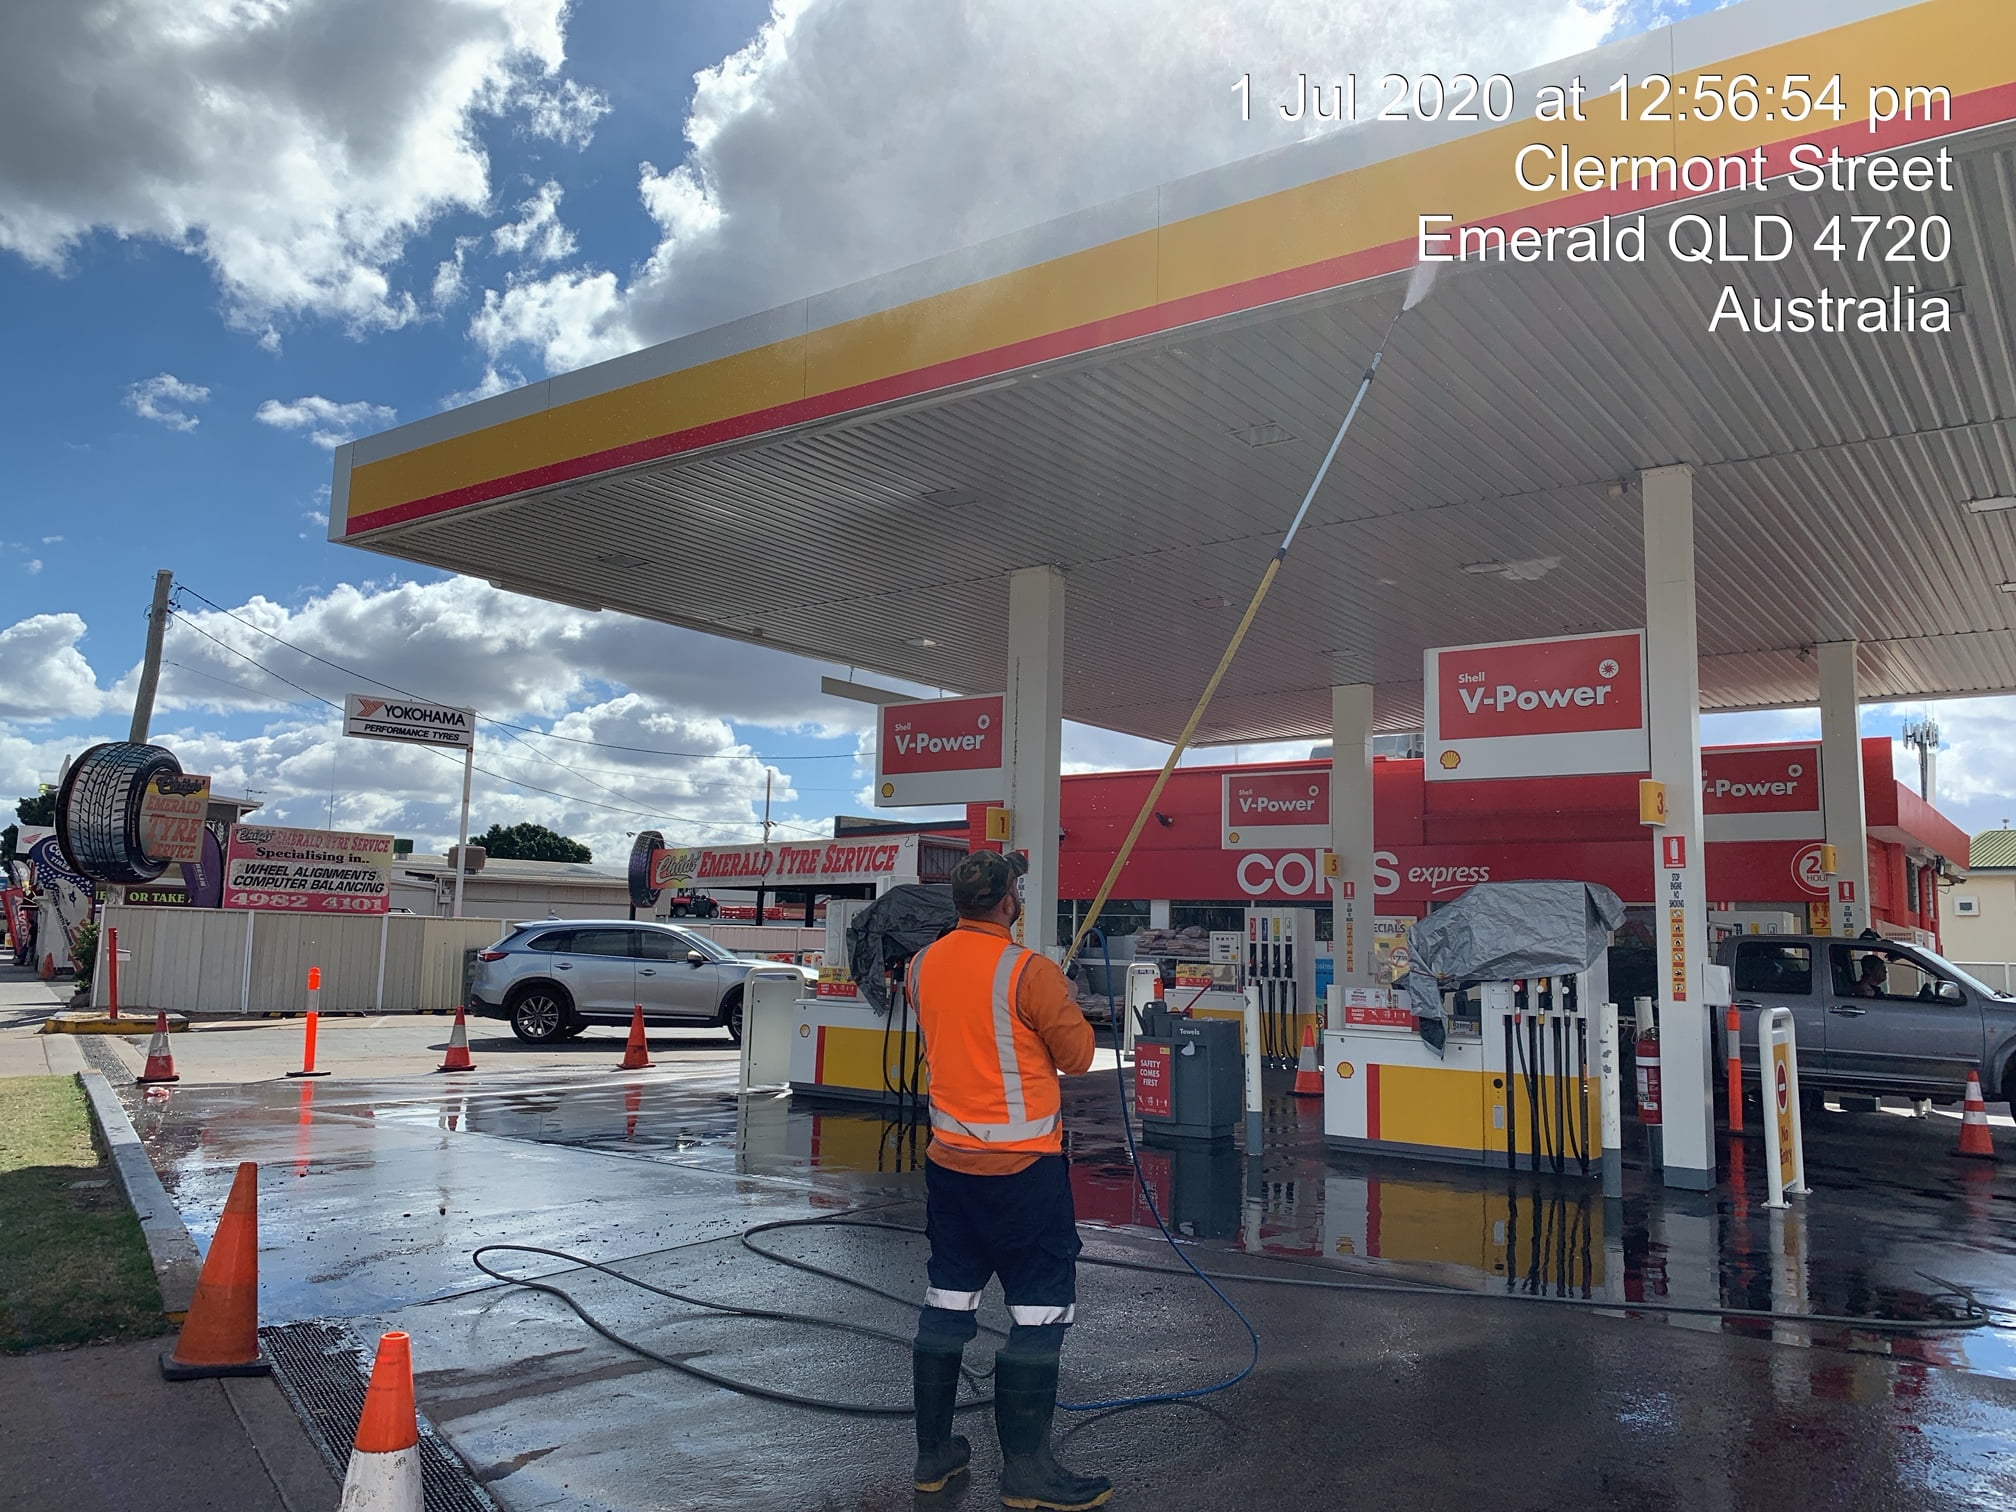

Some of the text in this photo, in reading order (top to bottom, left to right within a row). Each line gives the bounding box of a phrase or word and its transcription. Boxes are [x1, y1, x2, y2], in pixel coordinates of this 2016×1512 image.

[1458, 671, 1485, 684] Shell
[1458, 683, 1612, 714] V-Power
[384, 704, 466, 726] YOKOHAMA
[364, 723, 460, 741] PERFORMANCE TYRES
[895, 721, 912, 732] Shell
[895, 733, 985, 755] V-Power
[145, 795, 202, 814] EMERALD
[1239, 797, 1314, 813] V-Power
[1656, 791, 1665, 815] 3
[147, 815, 202, 843] TYRE
[1000, 816, 1006, 834] 1
[148, 842, 196, 859] SERVICE
[277, 831, 322, 848] EMERALD
[326, 834, 350, 850] TYRE
[352, 836, 391, 853] SERVICE
[256, 847, 345, 863] Specialising
[697, 850, 774, 878] EMERALD
[776, 846, 822, 876] TYRE
[821, 844, 900, 874] SERVICE
[244, 863, 377, 881] WHEEL ALIGNMENTS
[1331, 859, 1337, 872] 5
[1806, 856, 1823, 874] 2
[233, 875, 385, 893] COMPUTER BALANCING
[1408, 864, 1490, 888] express
[129, 892, 148, 903] OR
[152, 892, 185, 903] TAKE
[230, 892, 383, 911] 4982 4101
[1374, 923, 1406, 933] ECIALS
[1140, 1059, 1161, 1068] SAFETY
[1140, 1069, 1160, 1078] COMES
[1143, 1078, 1158, 1087] FIRST
[1781, 1126, 1789, 1141] No
